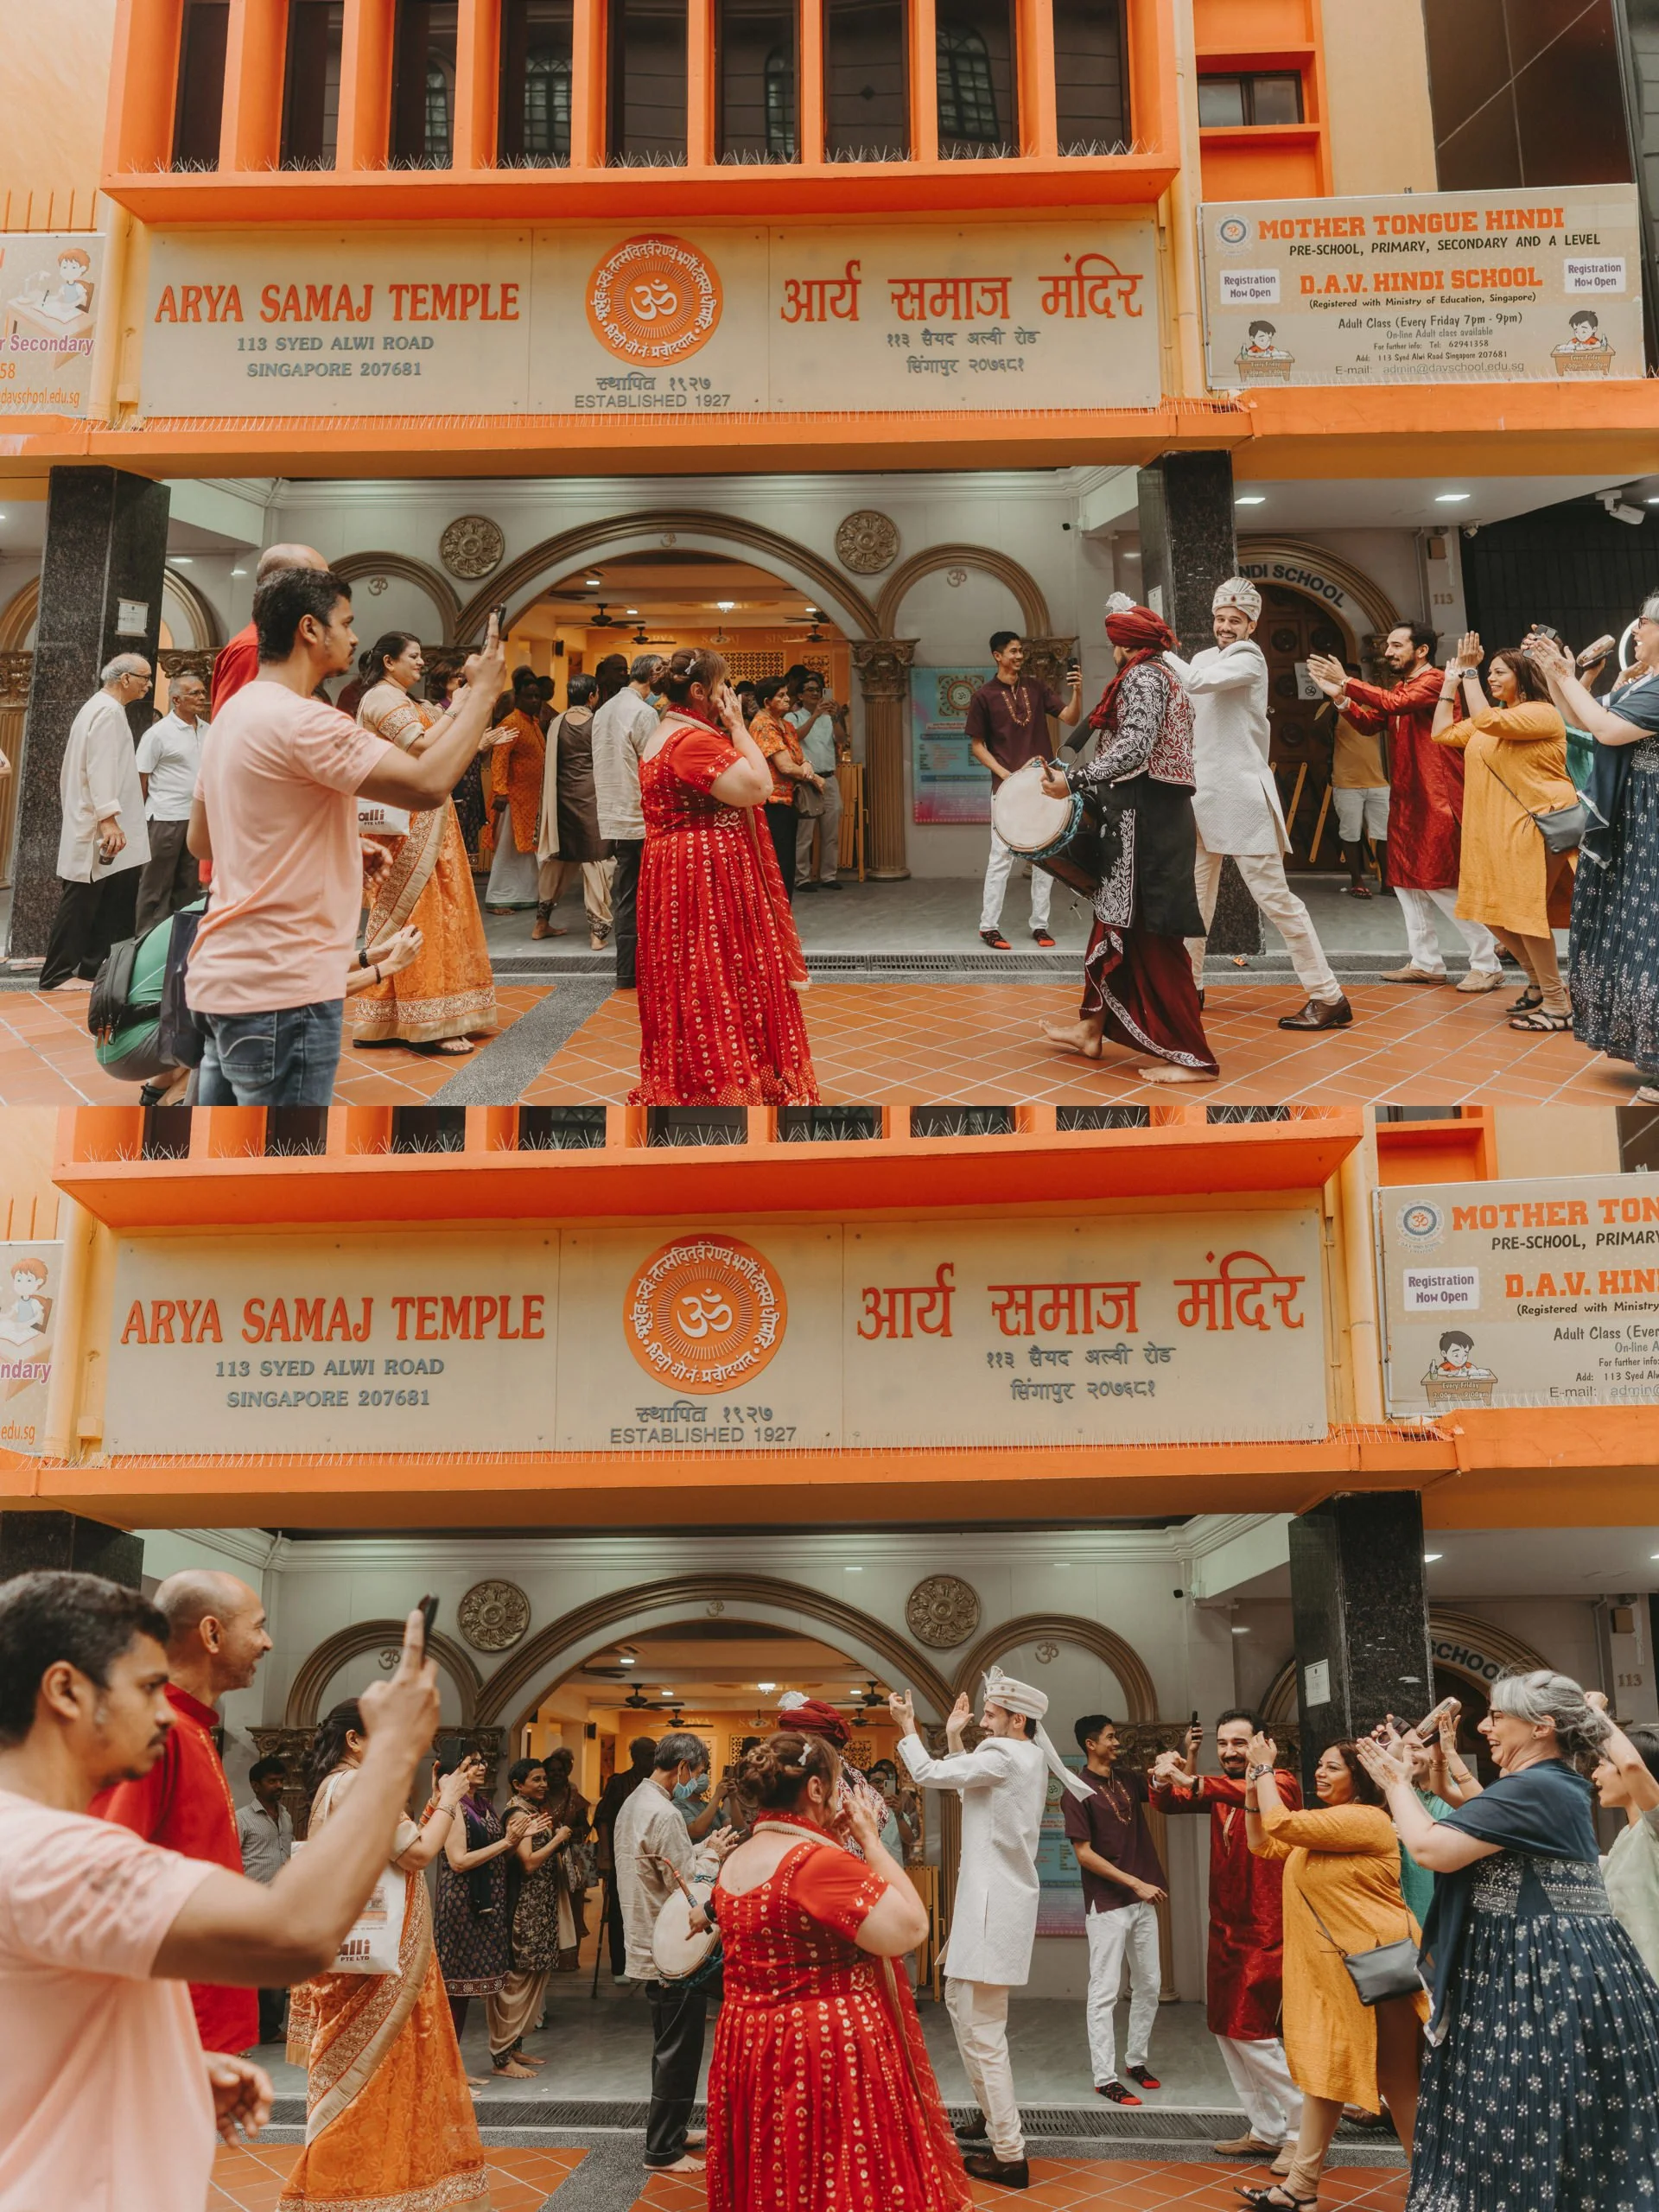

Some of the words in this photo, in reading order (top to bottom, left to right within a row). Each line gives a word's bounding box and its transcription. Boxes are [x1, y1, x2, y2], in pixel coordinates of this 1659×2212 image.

[1258, 216, 1366, 240] MOTHER
[1372, 211, 1478, 235] TONGUE
[1485, 207, 1564, 231] HINDI
[1289, 243, 1363, 257] PRE-SCHOOL,
[1371, 239, 1430, 254] PRIMARY,
[1438, 237, 1508, 251] SECONDARY
[1516, 235, 1541, 247] AND
[1548, 235, 1557, 246] A
[1565, 233, 1601, 246] LEVEL
[1567, 264, 1622, 276] Registration
[780, 260, 862, 323] आर्य
[887, 276, 1013, 321] समाज
[1038, 252, 1144, 319] मंदिर
[1224, 276, 1276, 288] Registration
[1300, 273, 1368, 295] D.A.V.
[1373, 270, 1445, 293] HINDI
[1451, 267, 1543, 289] SCHOOL
[1574, 277, 1593, 288] Now
[1594, 276, 1618, 289] Open
[154, 284, 245, 323] ARYA
[258, 283, 374, 323] SAMAJ
[387, 283, 521, 321] TEMPLE
[1230, 289, 1248, 298] Now
[1249, 289, 1272, 300] Open
[1309, 298, 1357, 310] (Registered
[1362, 299, 1381, 308] with
[1385, 296, 1421, 308] Ministry
[1426, 296, 1436, 304] of
[1440, 295, 1485, 304] Education,
[1490, 292, 1536, 304] Singapore)
[1338, 318, 1363, 330] Adult
[1366, 317, 1391, 329] Class
[1395, 315, 1427, 328] (Every
[1430, 314, 1460, 327] Friday
[1464, 314, 1485, 327] 7pm
[1496, 311, 1523, 325] 9pm)
[887, 333, 911, 347] ११३
[921, 327, 958, 347] सैयद
[967, 327, 1007, 346] अल्वी
[1014, 327, 1041, 346] रोड
[1386, 330, 1413, 340] On-line
[1415, 329, 1436, 339] Adult
[1439, 328, 1458, 337] class
[1460, 327, 1494, 337] available
[10, 334, 94, 356] Secondary
[237, 337, 268, 353] 113
[276, 336, 324, 353] SYED
[330, 335, 376, 352] ALWI
[383, 335, 435, 352] ROAD
[1427, 352, 1443, 360] Road
[1445, 352, 1476, 361] Singapore
[1478, 350, 1507, 359] 207681
[246, 363, 353, 378] SINGAPORE
[359, 361, 423, 378] 207681
[906, 355, 959, 377] सिंगापुर
[1335, 365, 1373, 375] E-mail:
[1382, 360, 1525, 375] admin@davschool.edu.sg
[595, 372, 657, 391] स्थापित
[574, 394, 688, 409] ESTABLISHED
[695, 394, 731, 408] 1927
[1238, 564, 1268, 579] NDI
[1272, 564, 1344, 608] SCHOOL
[1433, 594, 1453, 605] 113
[1452, 1200, 1589, 1231] MOTHER
[1491, 1234, 1586, 1251] PRE-SCHOOL,
[1408, 1274, 1475, 1290] Registration
[1504, 1271, 1591, 1298] D.A.V.
[1599, 1268, 1659, 1295] HIN
[857, 1262, 956, 1340] आर्य
[987, 1280, 1141, 1336] समाज
[1173, 1250, 1306, 1331] मंदिर
[1415, 1292, 1439, 1304] Now
[1440, 1291, 1469, 1306] Open
[1516, 1303, 1578, 1317] (Registered
[1584, 1301, 1607, 1313] with
[120, 1298, 223, 1344] ARYA
[241, 1297, 374, 1344] SAMAJ
[391, 1294, 545, 1341] TEMPLE
[1554, 1326, 1585, 1341] Adult
[1589, 1325, 1621, 1340] Class
[986, 1351, 1015, 1369] ११३
[1029, 1344, 1072, 1367] सैयद
[1085, 1343, 1134, 1365] अल्वी
[1144, 1340, 1176, 1364] रोड
[1614, 1341, 1649, 1353] On-line
[215, 1361, 251, 1377] 113
[259, 1360, 315, 1376] SYED
[323, 1359, 375, 1376] ALWI
[385, 1358, 444, 1376] ROAD
[1599, 1357, 1612, 1367] For
[1614, 1357, 1641, 1367] further
[1575, 1371, 1594, 1382] Add:
[1624, 1370, 1644, 1382] Syed
[226, 1389, 348, 1408] SINGAPORE
[359, 1389, 430, 1407] 207681
[1010, 1376, 1075, 1403] सिंगापुर
[1549, 1386, 1597, 1398] E-mail:
[635, 1400, 708, 1422] स्थापित
[610, 1427, 745, 1444] ESTABLISHED
[754, 1427, 797, 1442] 1927
[1431, 1640, 1503, 1681] CHOO
[1617, 1674, 1643, 1688] 113
